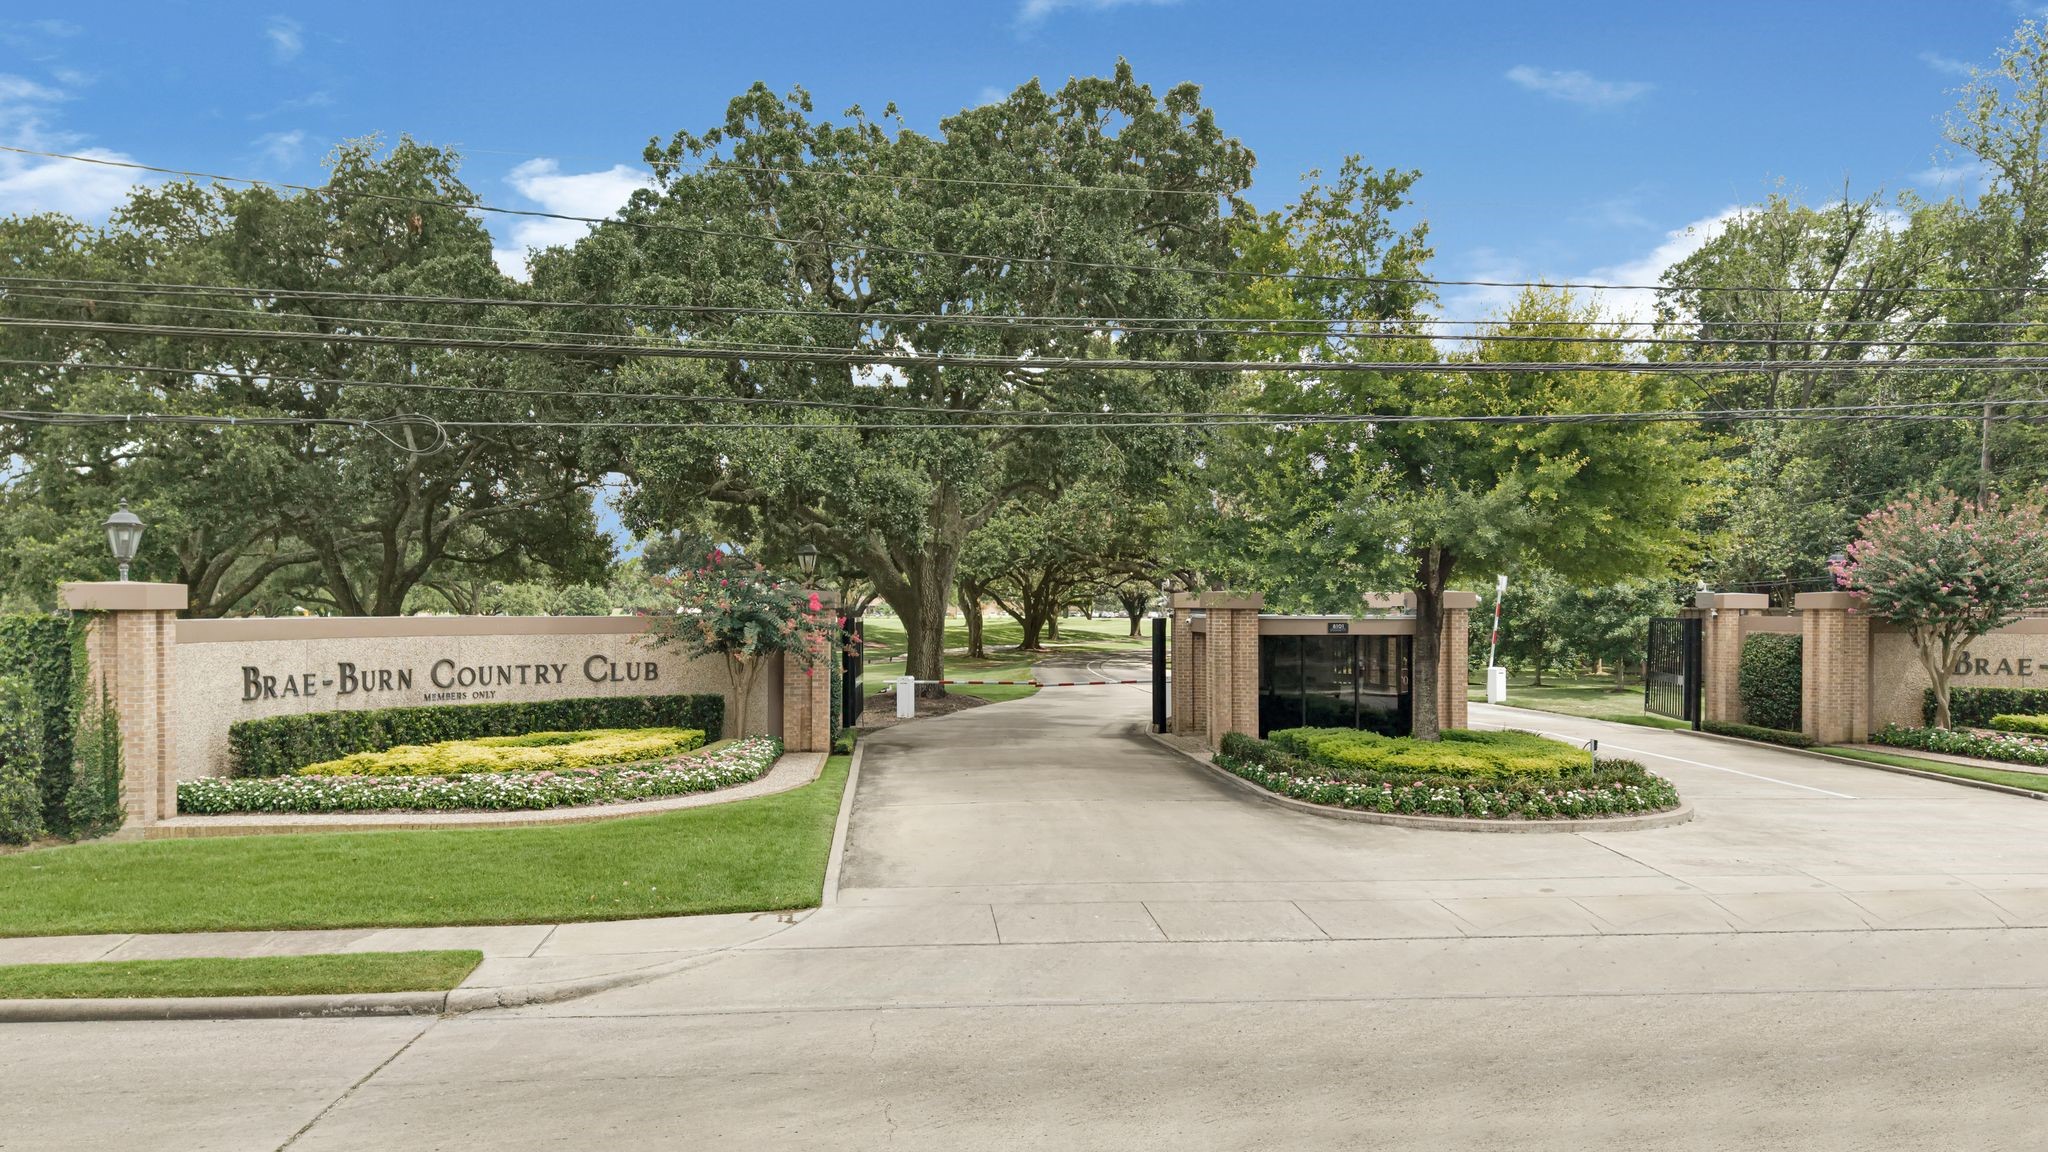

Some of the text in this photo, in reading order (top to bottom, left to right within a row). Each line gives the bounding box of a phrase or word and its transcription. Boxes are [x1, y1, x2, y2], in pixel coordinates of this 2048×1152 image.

[241, 654, 659, 701] BRAE-BURN COUNTRY CLUB
[423, 690, 496, 702] MEMBERS ONLY
